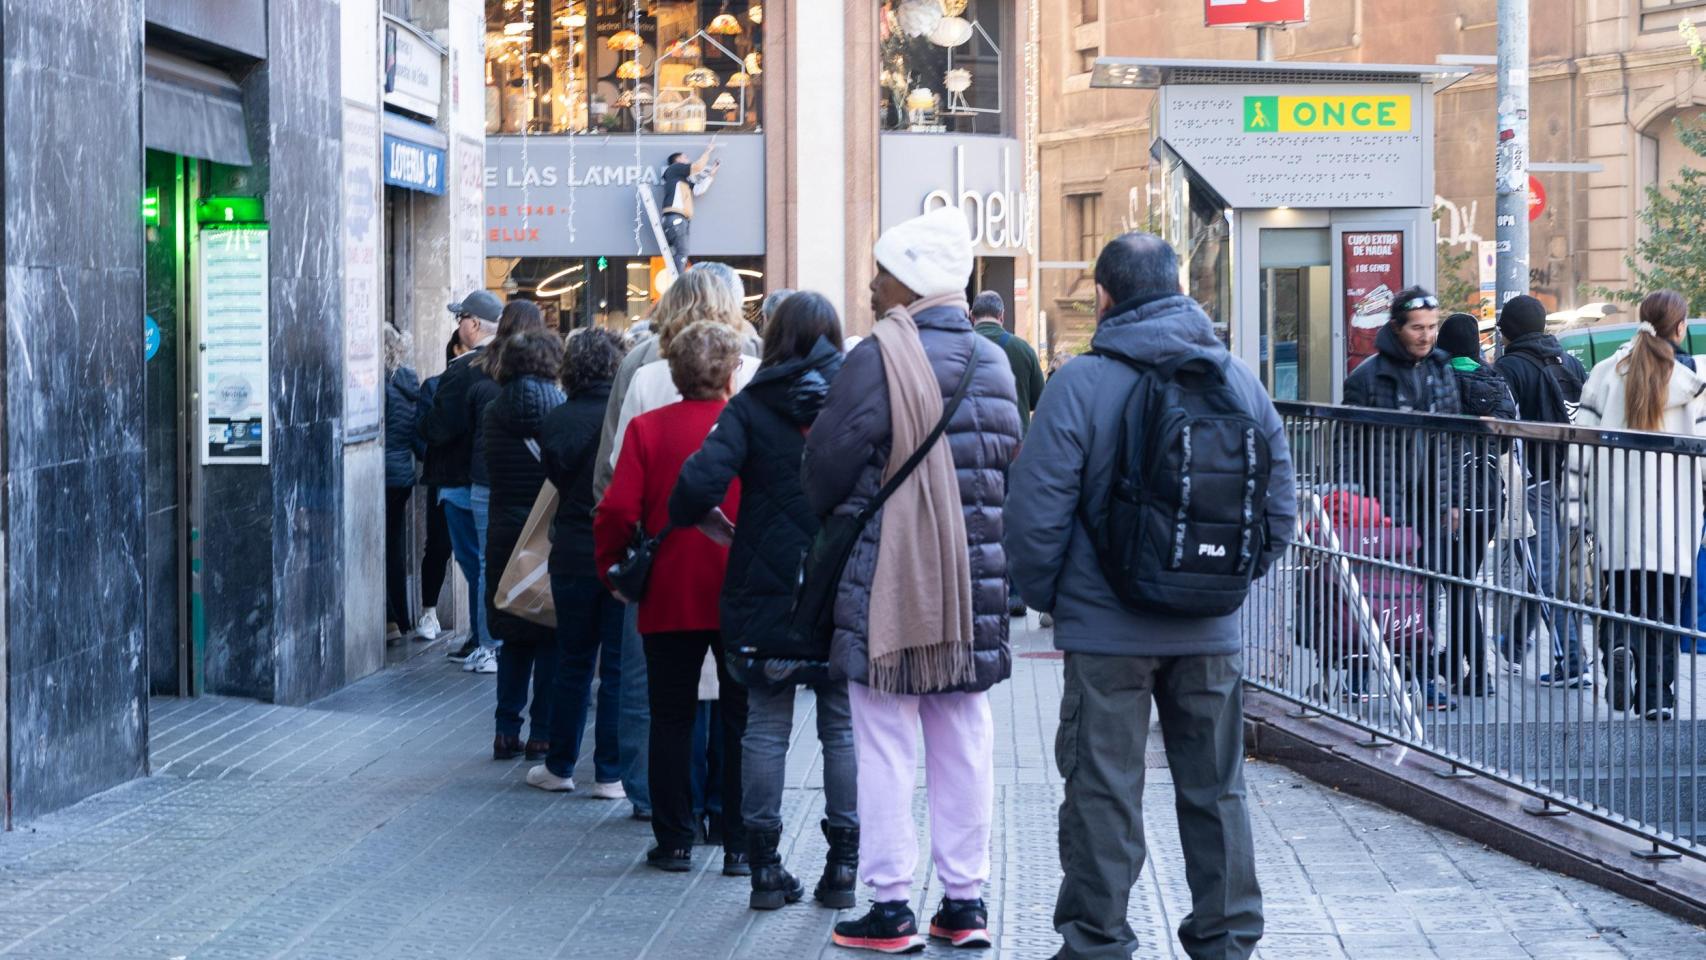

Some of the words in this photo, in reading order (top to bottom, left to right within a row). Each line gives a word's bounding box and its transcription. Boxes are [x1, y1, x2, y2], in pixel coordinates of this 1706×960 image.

[1293, 102, 1396, 126] ONCE
[484, 166, 498, 187] E
[506, 166, 558, 187] LAS
[568, 165, 667, 187] LÁMPA
[486, 204, 509, 217] DE
[488, 227, 541, 242] ELUX
[1371, 234, 1398, 245] EXTRA
[1353, 246, 1365, 256] DE
[1365, 245, 1393, 256] NADAL
[1199, 543, 1226, 557] FILA
